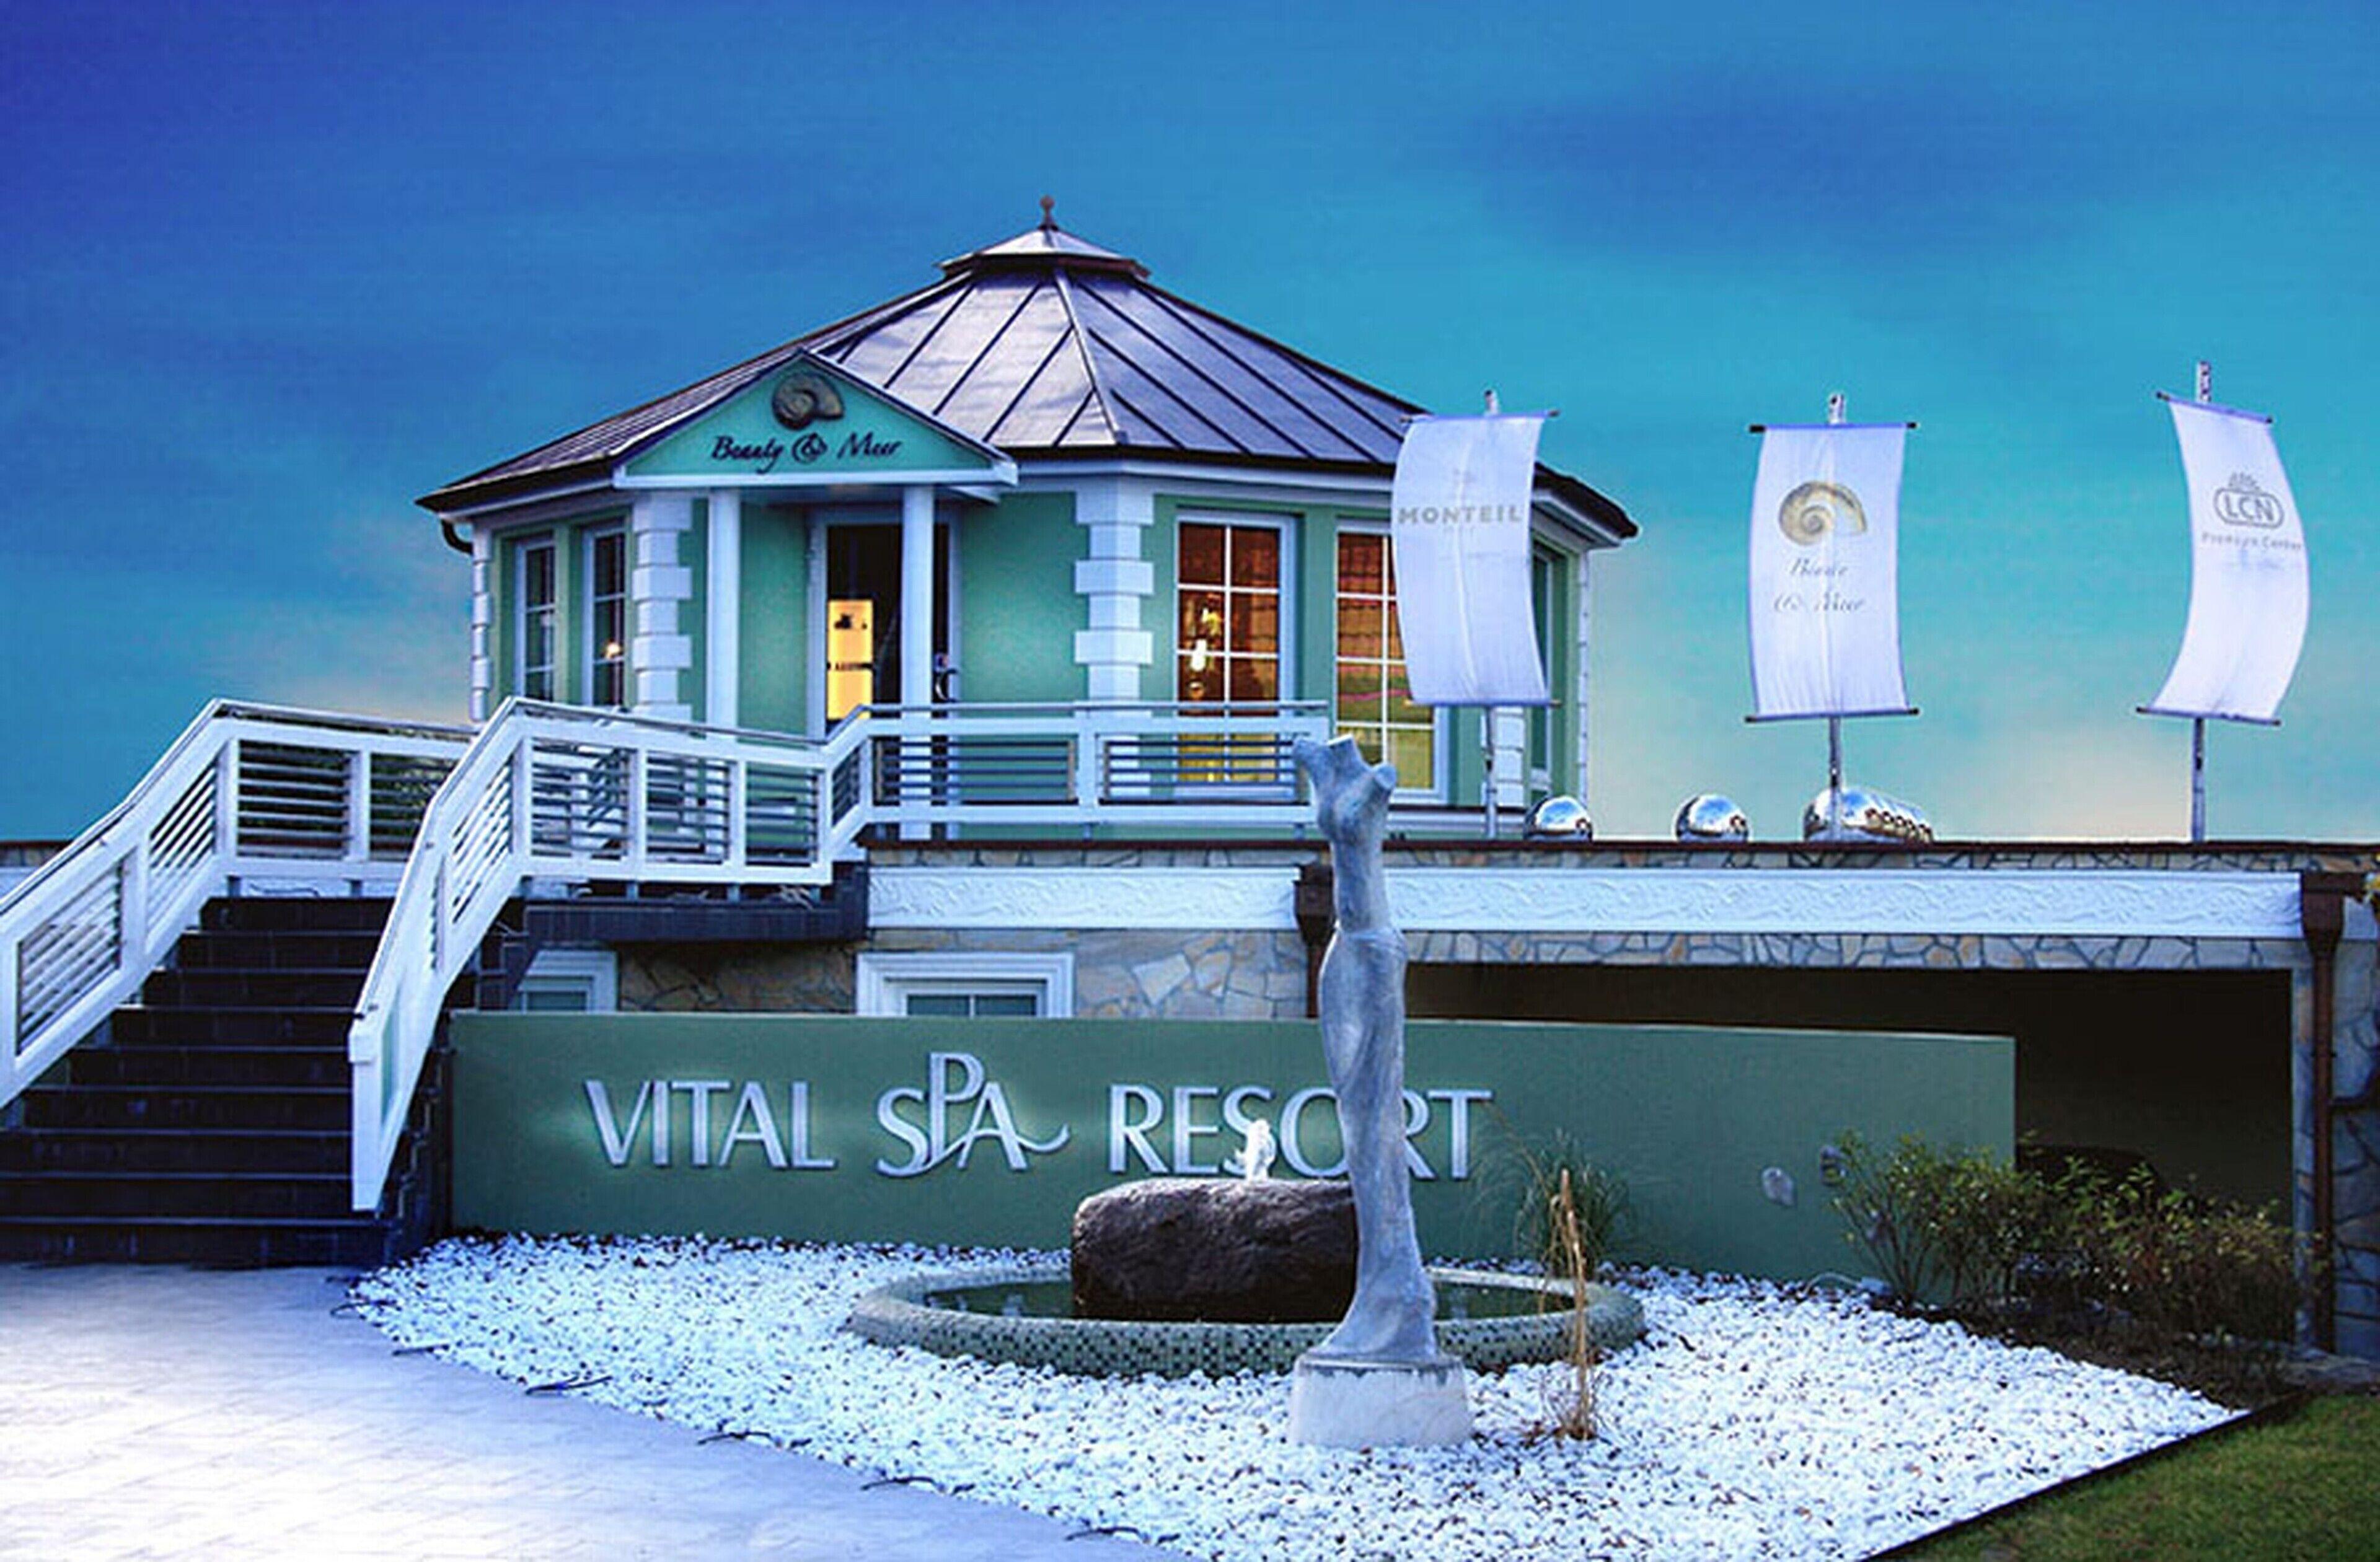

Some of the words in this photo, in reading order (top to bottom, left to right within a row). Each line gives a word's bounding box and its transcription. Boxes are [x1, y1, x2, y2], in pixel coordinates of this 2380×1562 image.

[1398, 504, 1522, 524] MONTEIL
[2224, 494, 2275, 522] LCN
[584, 1079, 837, 1169] VITAL
[876, 1050, 1070, 1177] SPA
[1106, 1083, 1494, 1180] RESORT
